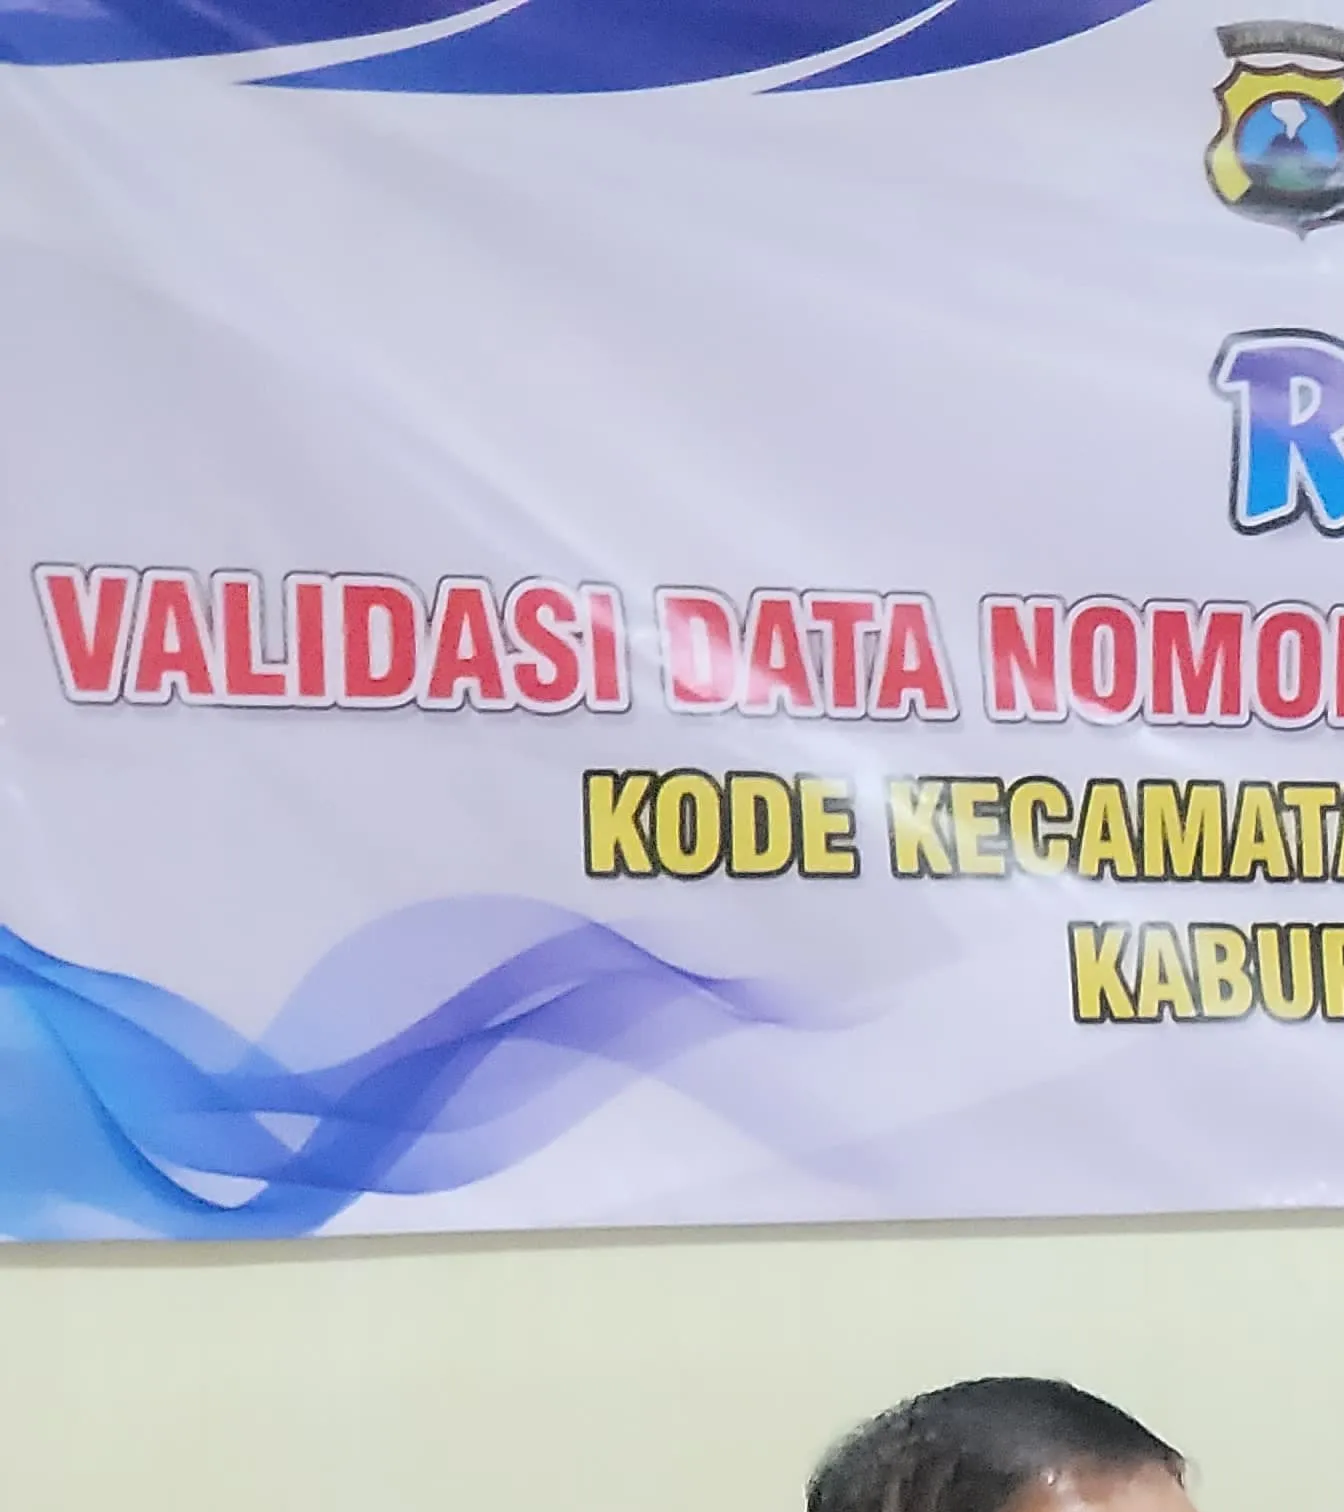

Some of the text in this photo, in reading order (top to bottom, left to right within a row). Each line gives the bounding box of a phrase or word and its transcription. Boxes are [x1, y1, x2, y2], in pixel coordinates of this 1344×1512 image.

[35, 564, 629, 711] VALIDASI
[656, 585, 959, 720] DATA
[583, 769, 859, 880] KODE
